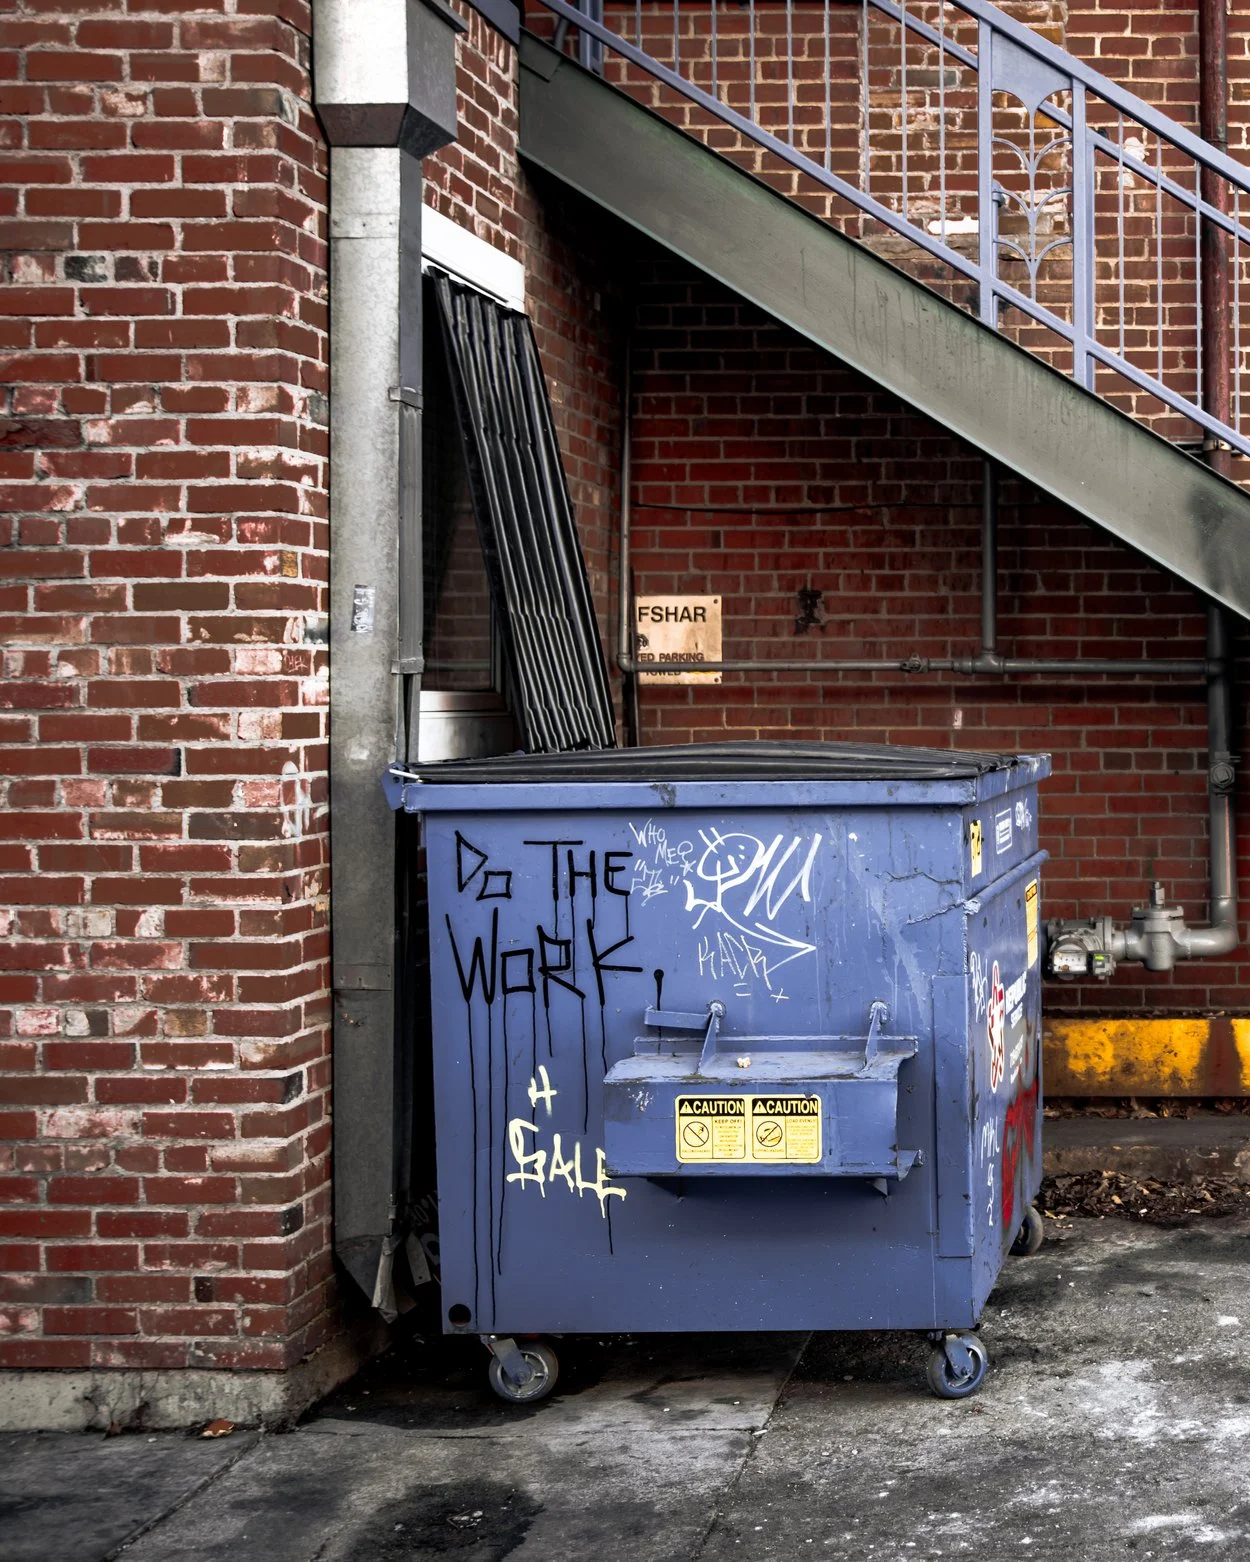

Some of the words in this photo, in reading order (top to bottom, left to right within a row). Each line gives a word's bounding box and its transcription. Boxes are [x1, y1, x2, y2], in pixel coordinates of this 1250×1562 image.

[658, 652, 704, 662] PARKING
[523, 840, 634, 900] THE
[692, 1100, 745, 1115] CAUTION
[766, 1100, 818, 1115] CAUTION
